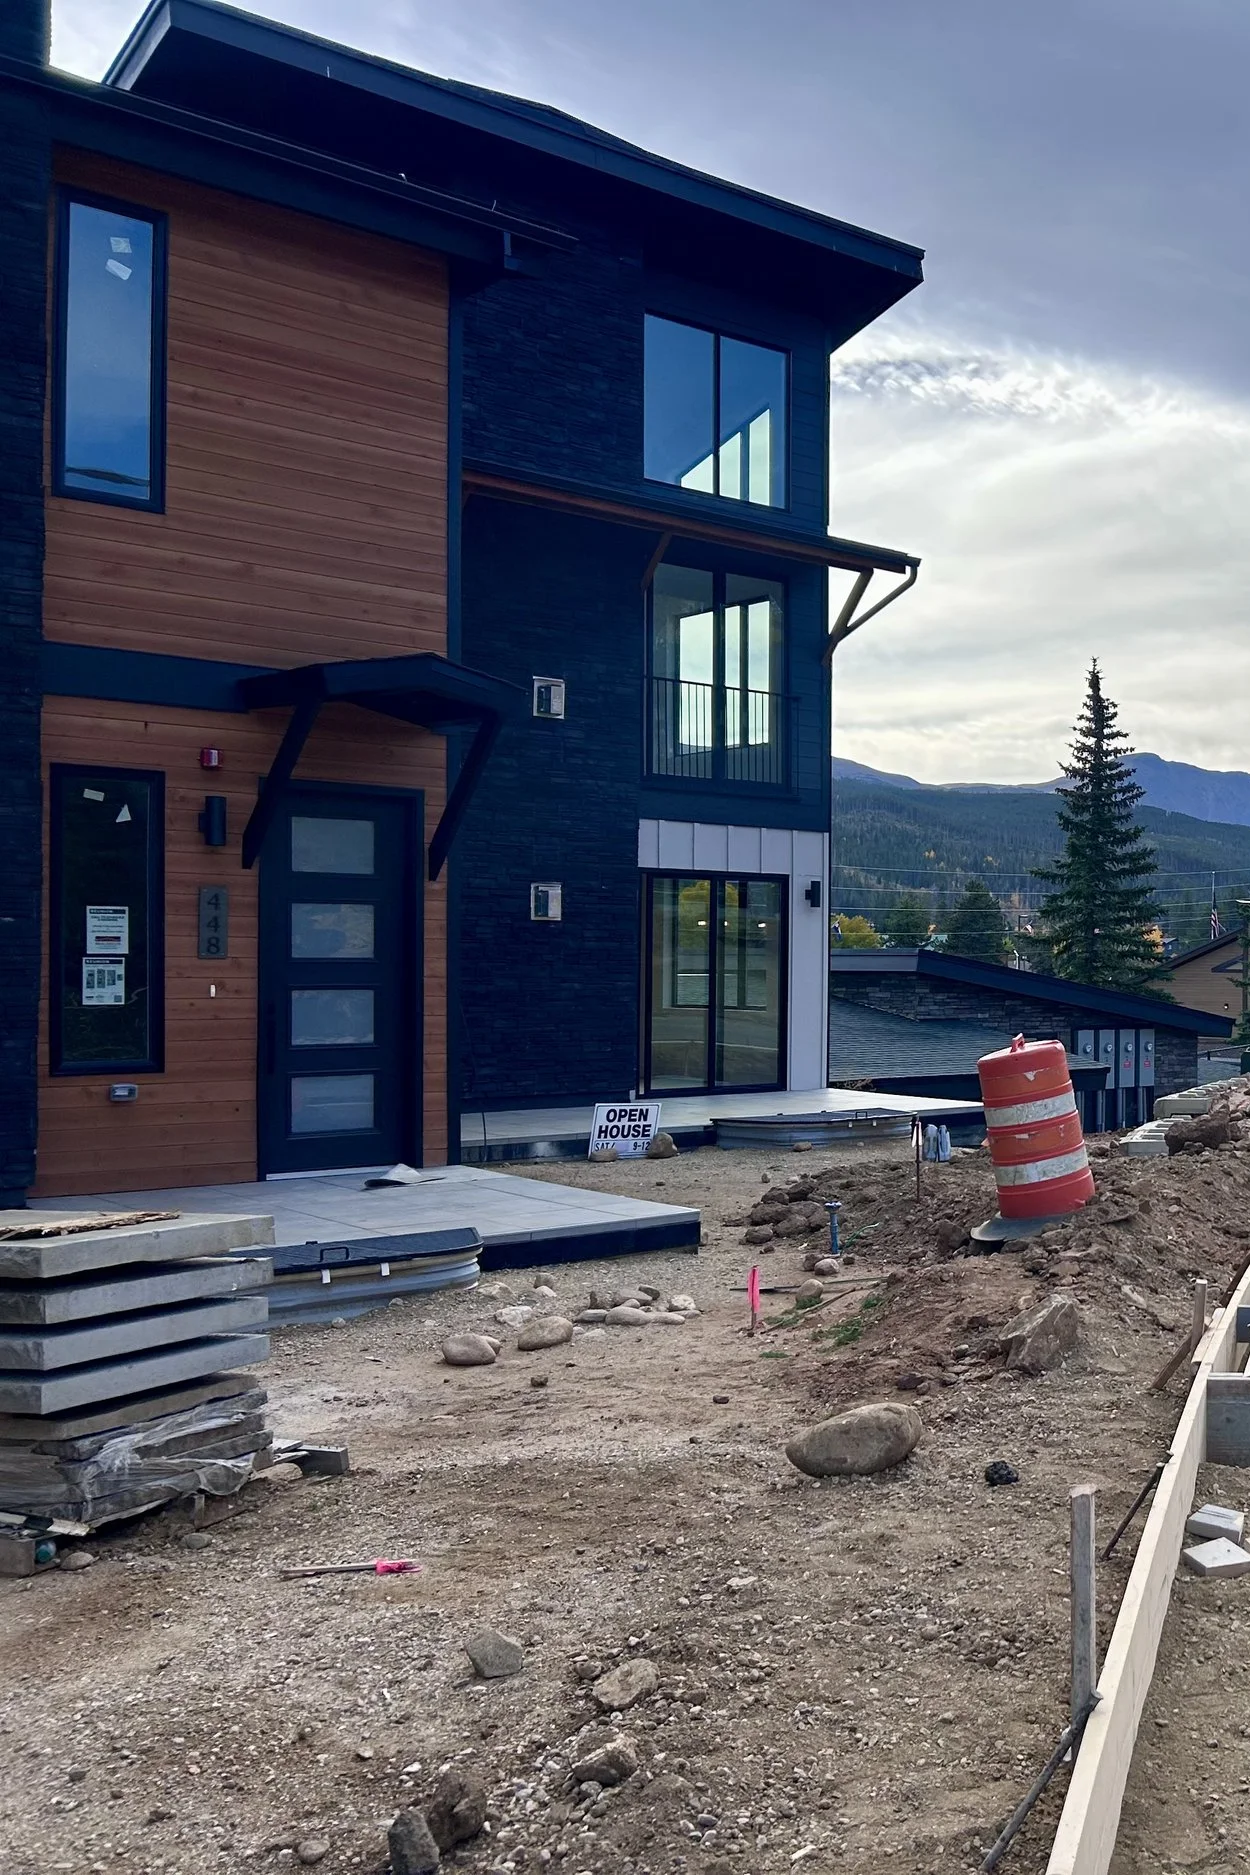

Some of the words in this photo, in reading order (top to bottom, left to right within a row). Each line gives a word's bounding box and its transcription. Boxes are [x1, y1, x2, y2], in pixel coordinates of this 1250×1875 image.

[207, 893, 221, 955] 448
[606, 1108, 649, 1123] OPEN
[597, 1124, 652, 1139] HOUSE
